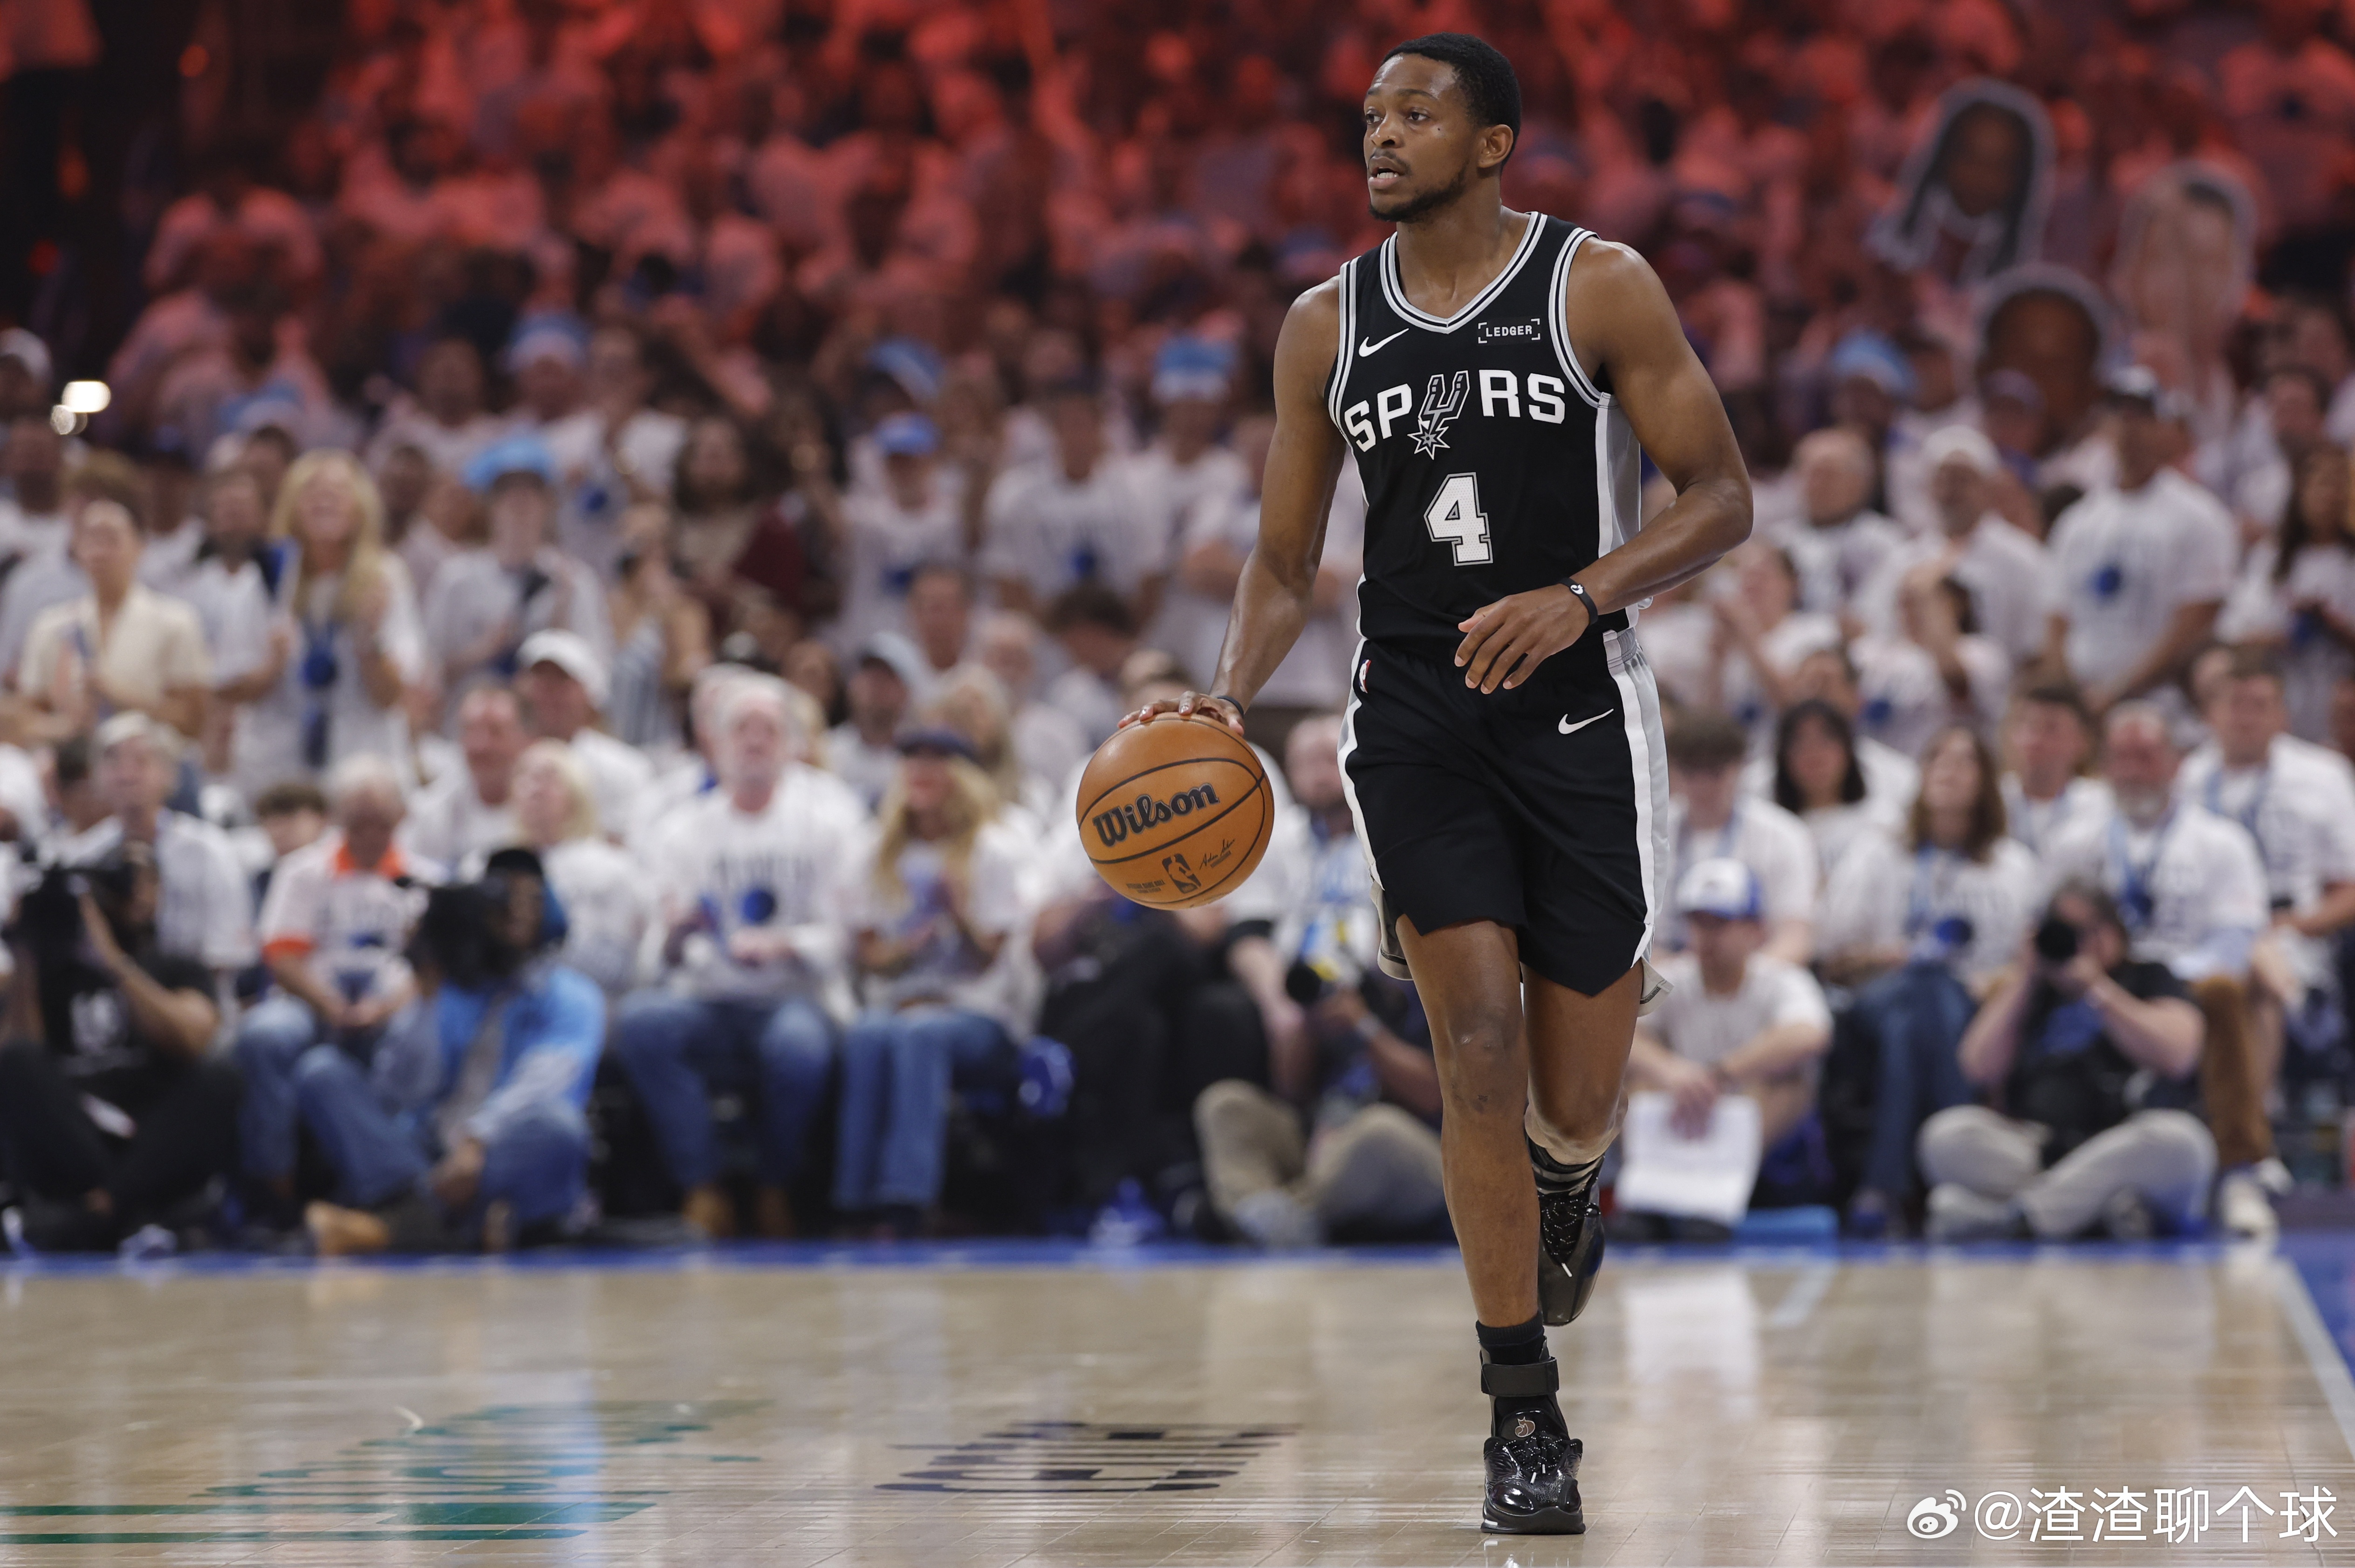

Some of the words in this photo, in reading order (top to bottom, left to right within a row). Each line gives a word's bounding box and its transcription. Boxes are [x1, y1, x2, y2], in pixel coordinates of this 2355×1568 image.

[1486, 325, 1533, 337] LEDGER
[1424, 472, 1493, 566] 4
[1092, 783, 1219, 847] Wilson
